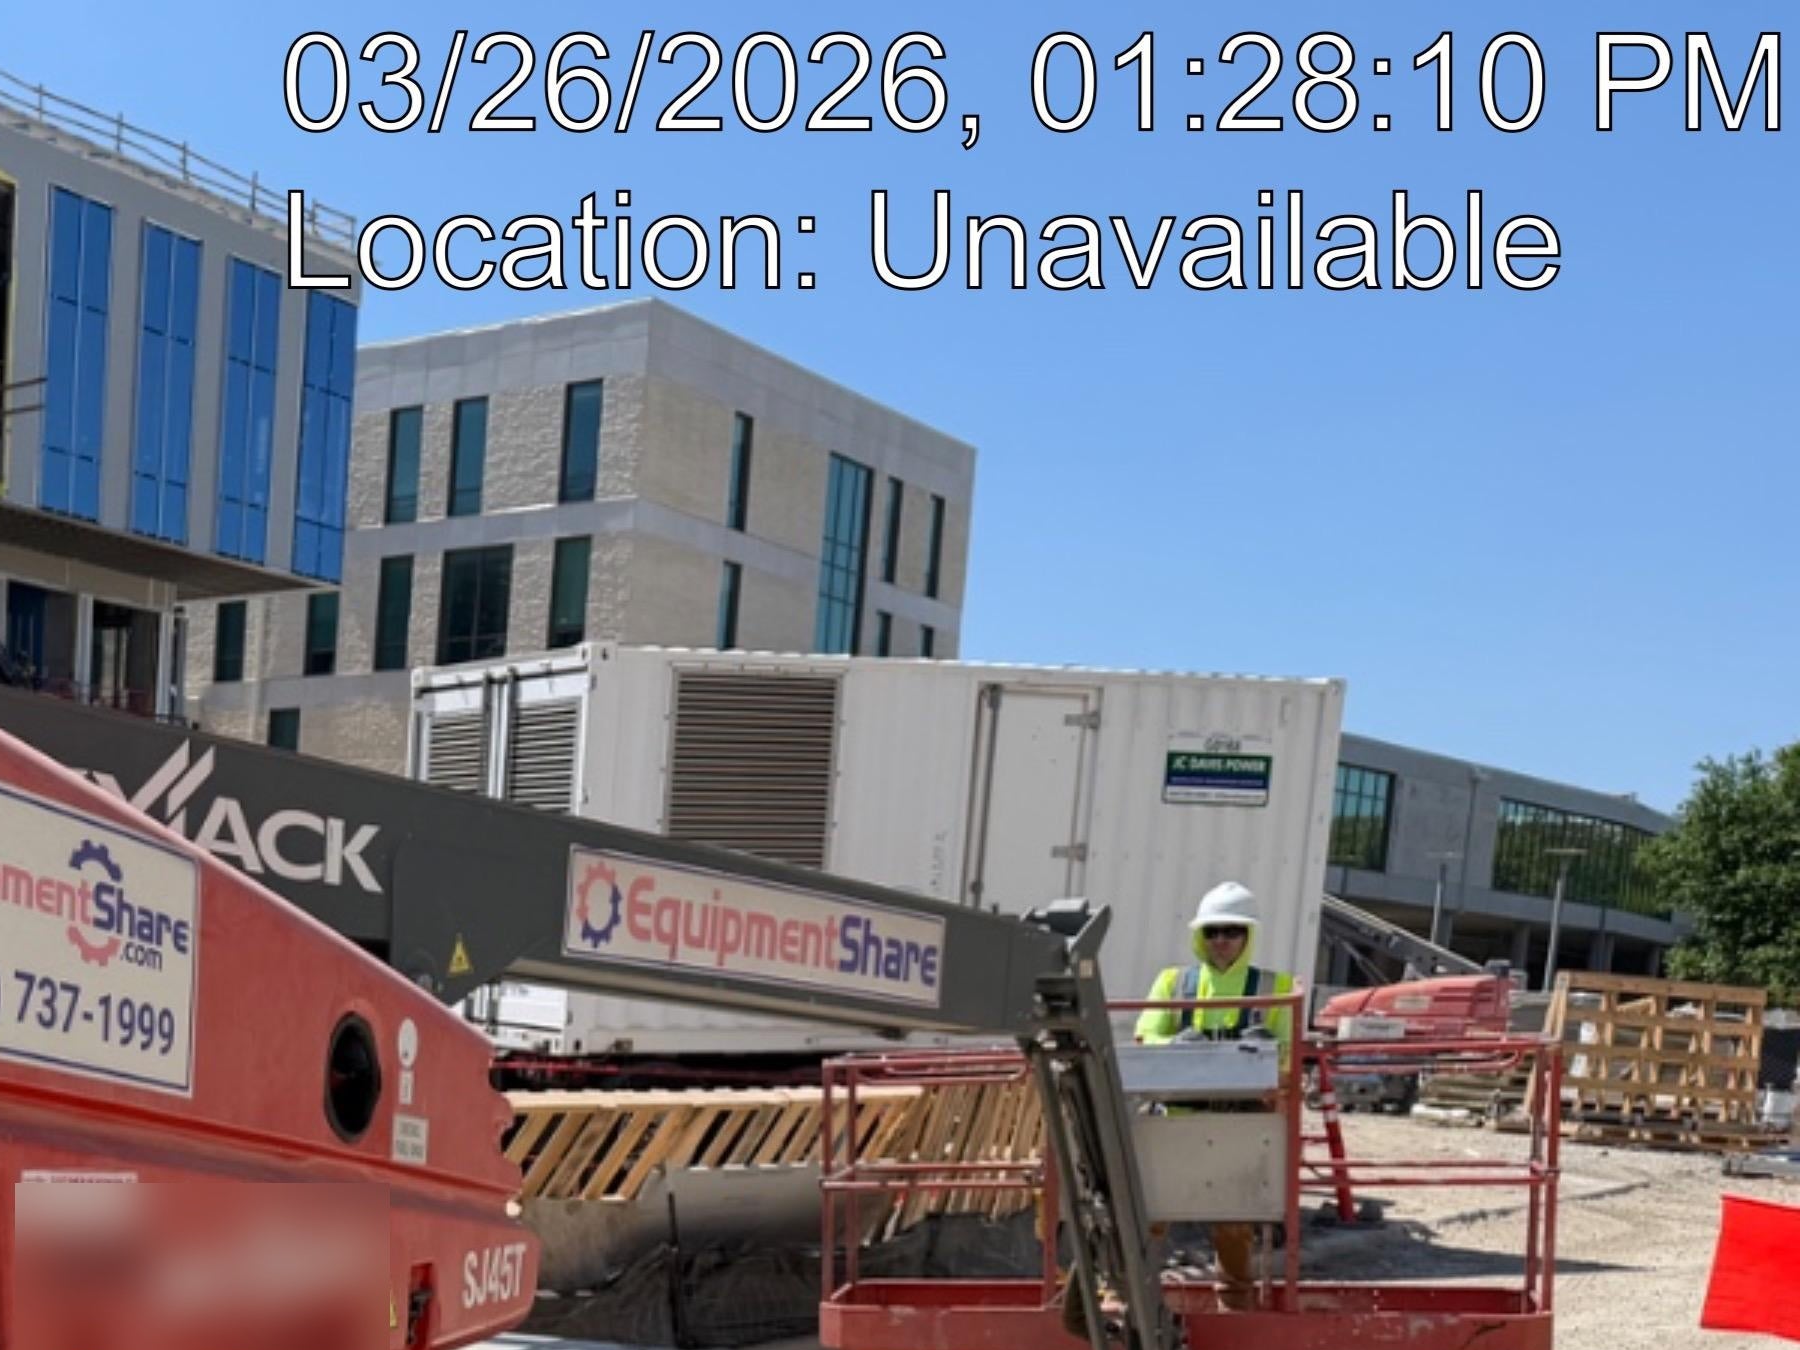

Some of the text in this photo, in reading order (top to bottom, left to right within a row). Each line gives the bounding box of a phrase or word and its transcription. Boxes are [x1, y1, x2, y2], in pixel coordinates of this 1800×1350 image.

[626, 874, 938, 987] EquipmentShare
[14, 970, 176, 1055] 737-1999
[462, 1242, 528, 1309] SJ45T
